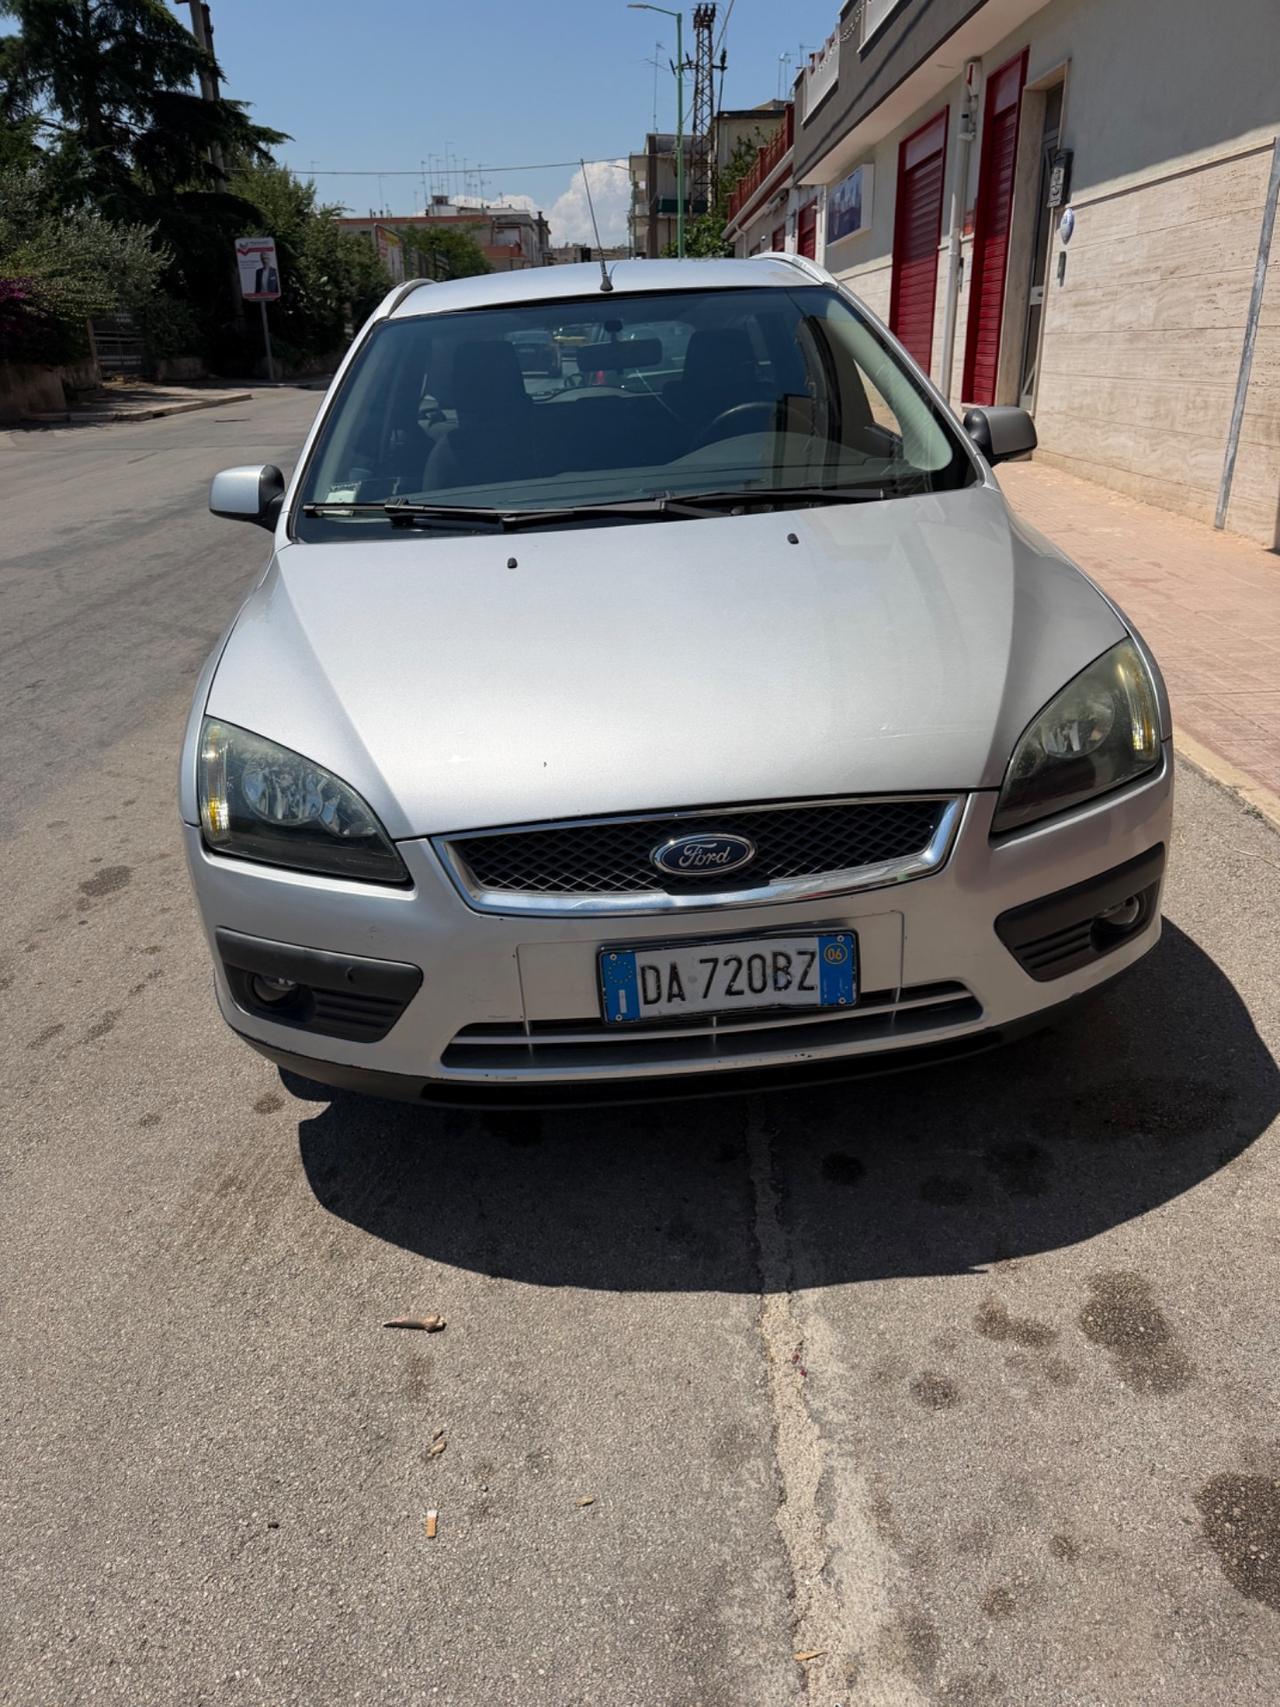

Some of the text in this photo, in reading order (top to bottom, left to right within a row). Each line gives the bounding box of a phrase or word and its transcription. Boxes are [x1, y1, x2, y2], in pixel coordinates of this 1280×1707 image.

[679, 843, 731, 867] Ford
[827, 949, 842, 960] 06
[640, 950, 817, 1005] DA 720BZ
